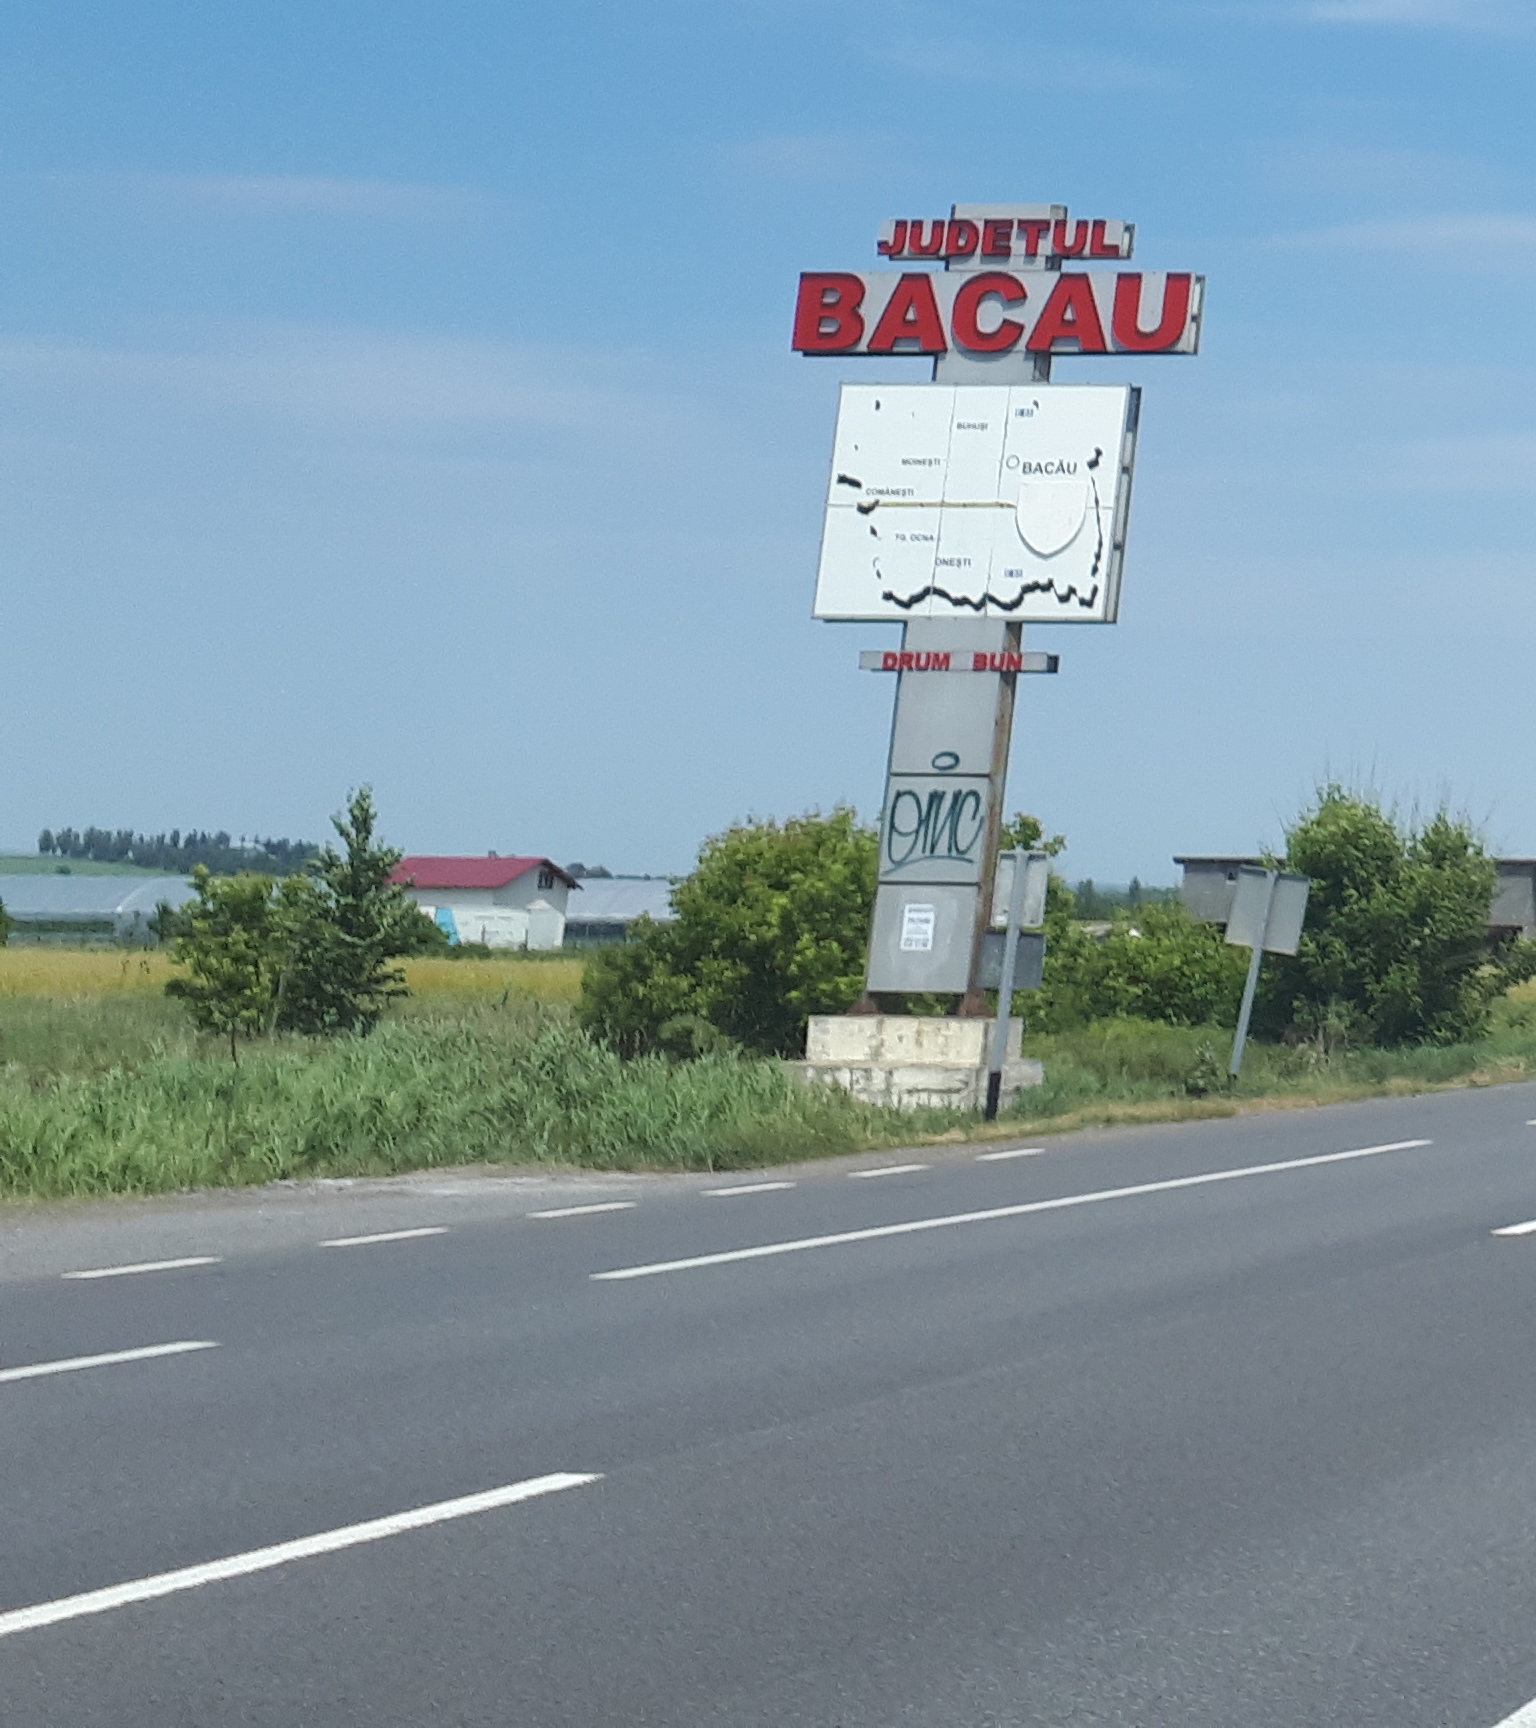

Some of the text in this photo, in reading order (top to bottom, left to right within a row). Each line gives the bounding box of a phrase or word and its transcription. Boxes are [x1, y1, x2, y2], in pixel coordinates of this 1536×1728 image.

[877, 219, 1121, 257] JUDETUL
[792, 272, 1192, 353] BACAU
[1022, 459, 1078, 475] BACĂU
[882, 652, 1024, 672] DRUM BUN
